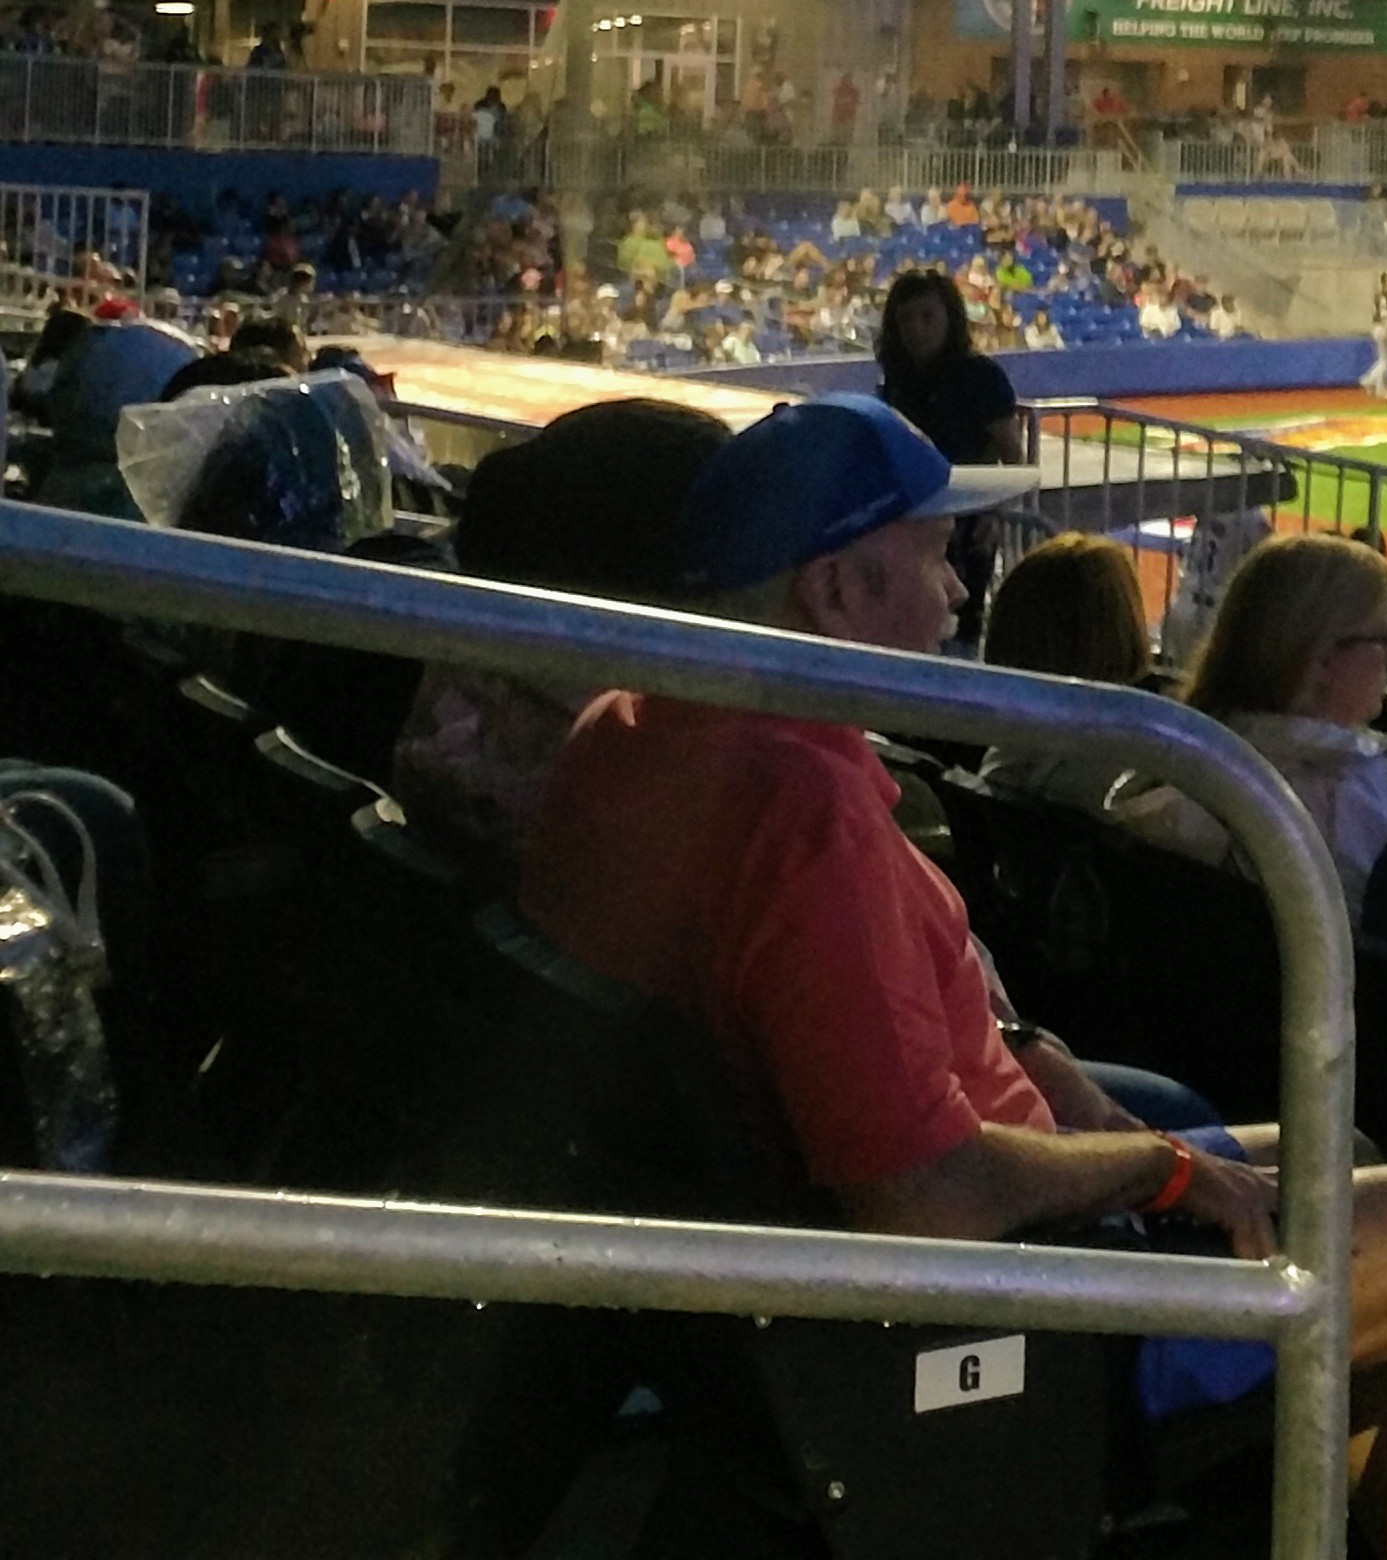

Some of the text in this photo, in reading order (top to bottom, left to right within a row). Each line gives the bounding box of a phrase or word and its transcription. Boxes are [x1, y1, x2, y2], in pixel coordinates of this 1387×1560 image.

[1113, 19, 1176, 38] HELPING
[1180, 21, 1209, 39] THE
[1212, 23, 1264, 41] WORLD
[959, 1354, 980, 1392] G
